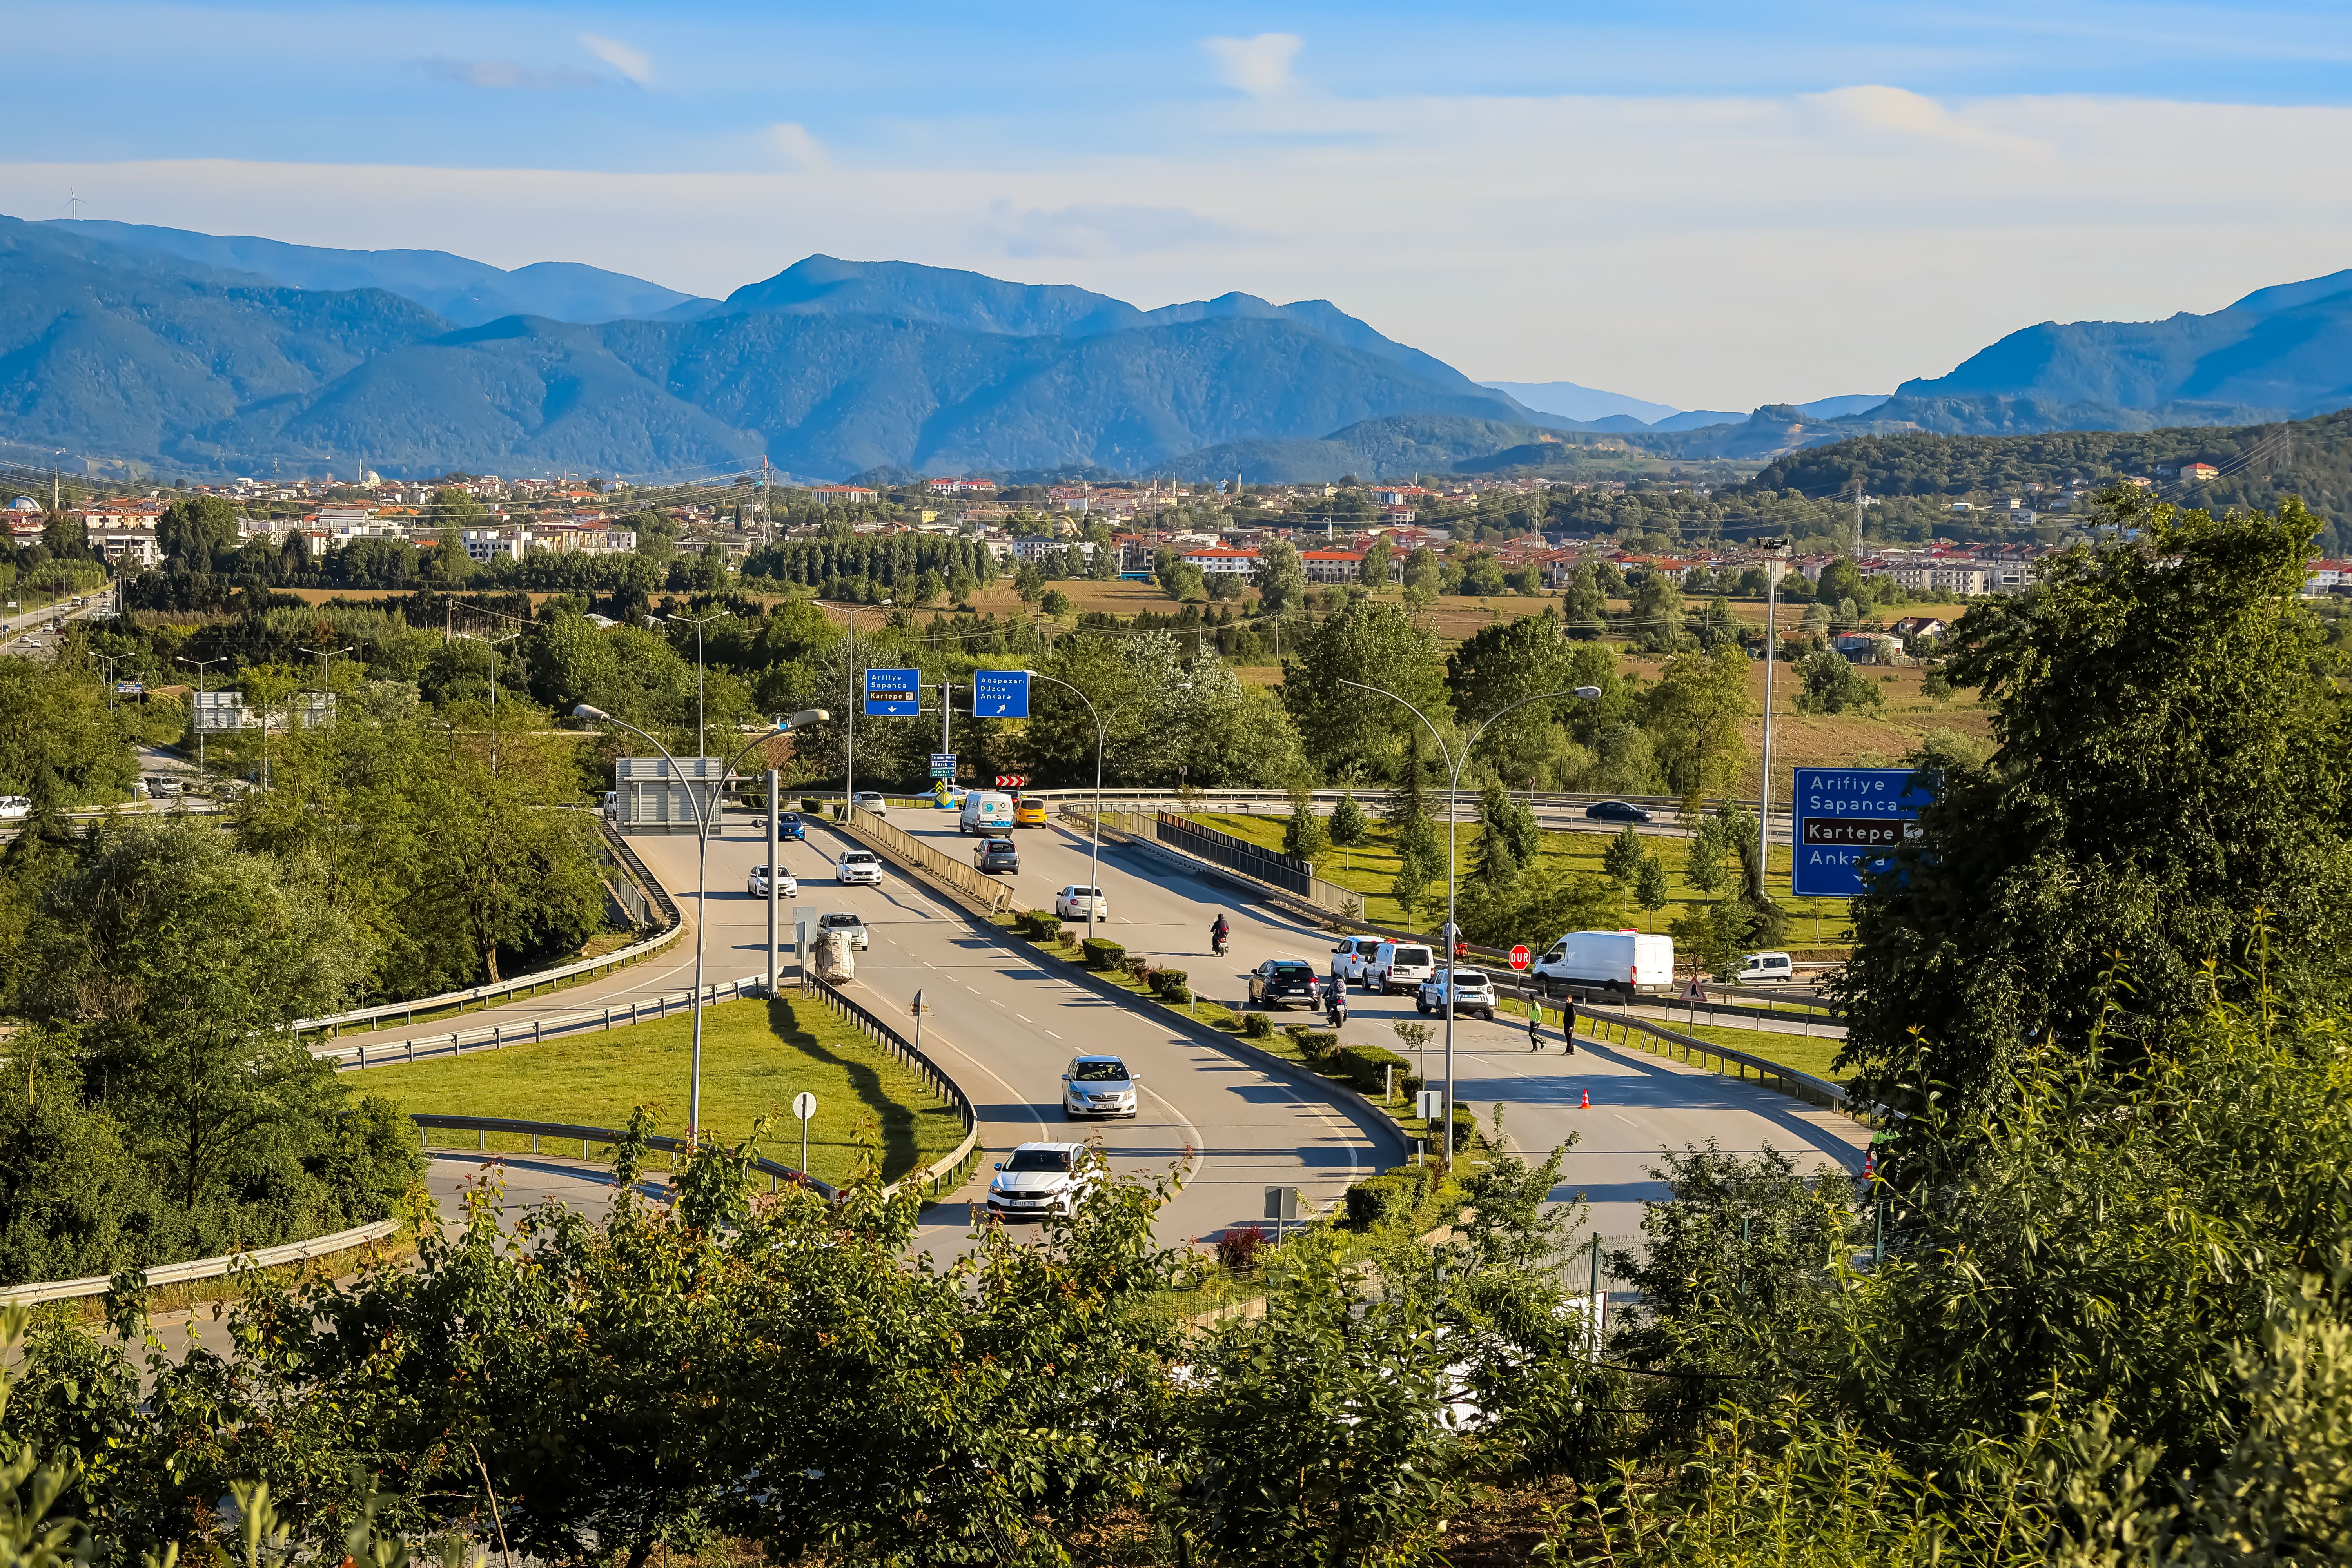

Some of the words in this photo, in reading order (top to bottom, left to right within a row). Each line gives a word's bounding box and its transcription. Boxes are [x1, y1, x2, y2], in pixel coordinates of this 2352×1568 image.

[1811, 776, 1885, 794] Arifiye
[1810, 795, 1897, 814] Sapanca
[1809, 824, 1894, 843] Kartepe
[1511, 953, 1528, 962] DUR
